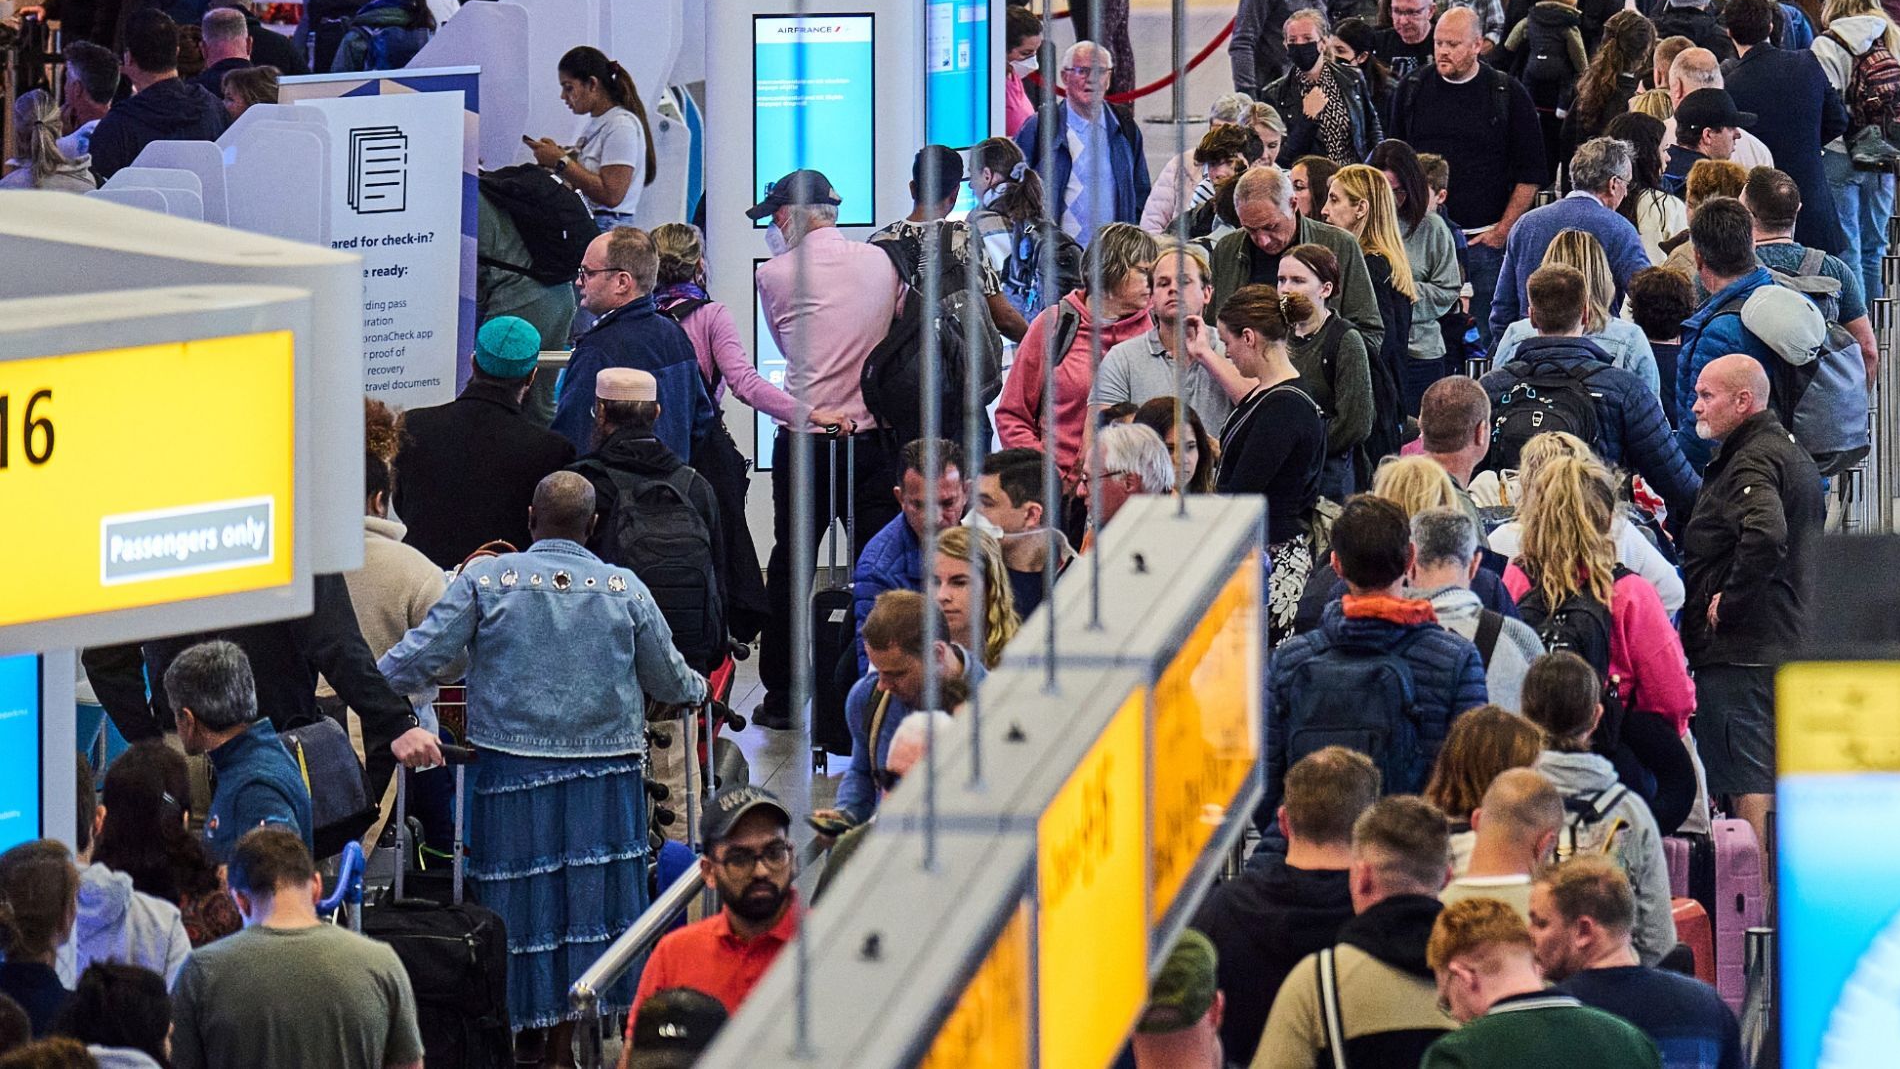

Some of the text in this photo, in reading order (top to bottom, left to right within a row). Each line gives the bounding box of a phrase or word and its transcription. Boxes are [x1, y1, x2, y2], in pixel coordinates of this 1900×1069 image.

[777, 26, 832, 34] AIRFRANCE
[360, 235, 379, 248] for
[381, 232, 435, 247] check-in?
[371, 264, 409, 279] ready:
[388, 299, 408, 310] pass
[416, 331, 434, 340] app
[369, 347, 394, 361] proof
[395, 346, 406, 357] of
[367, 364, 405, 377] recovery
[365, 377, 441, 392] travel documents
[109, 515, 266, 564] Passengers only
